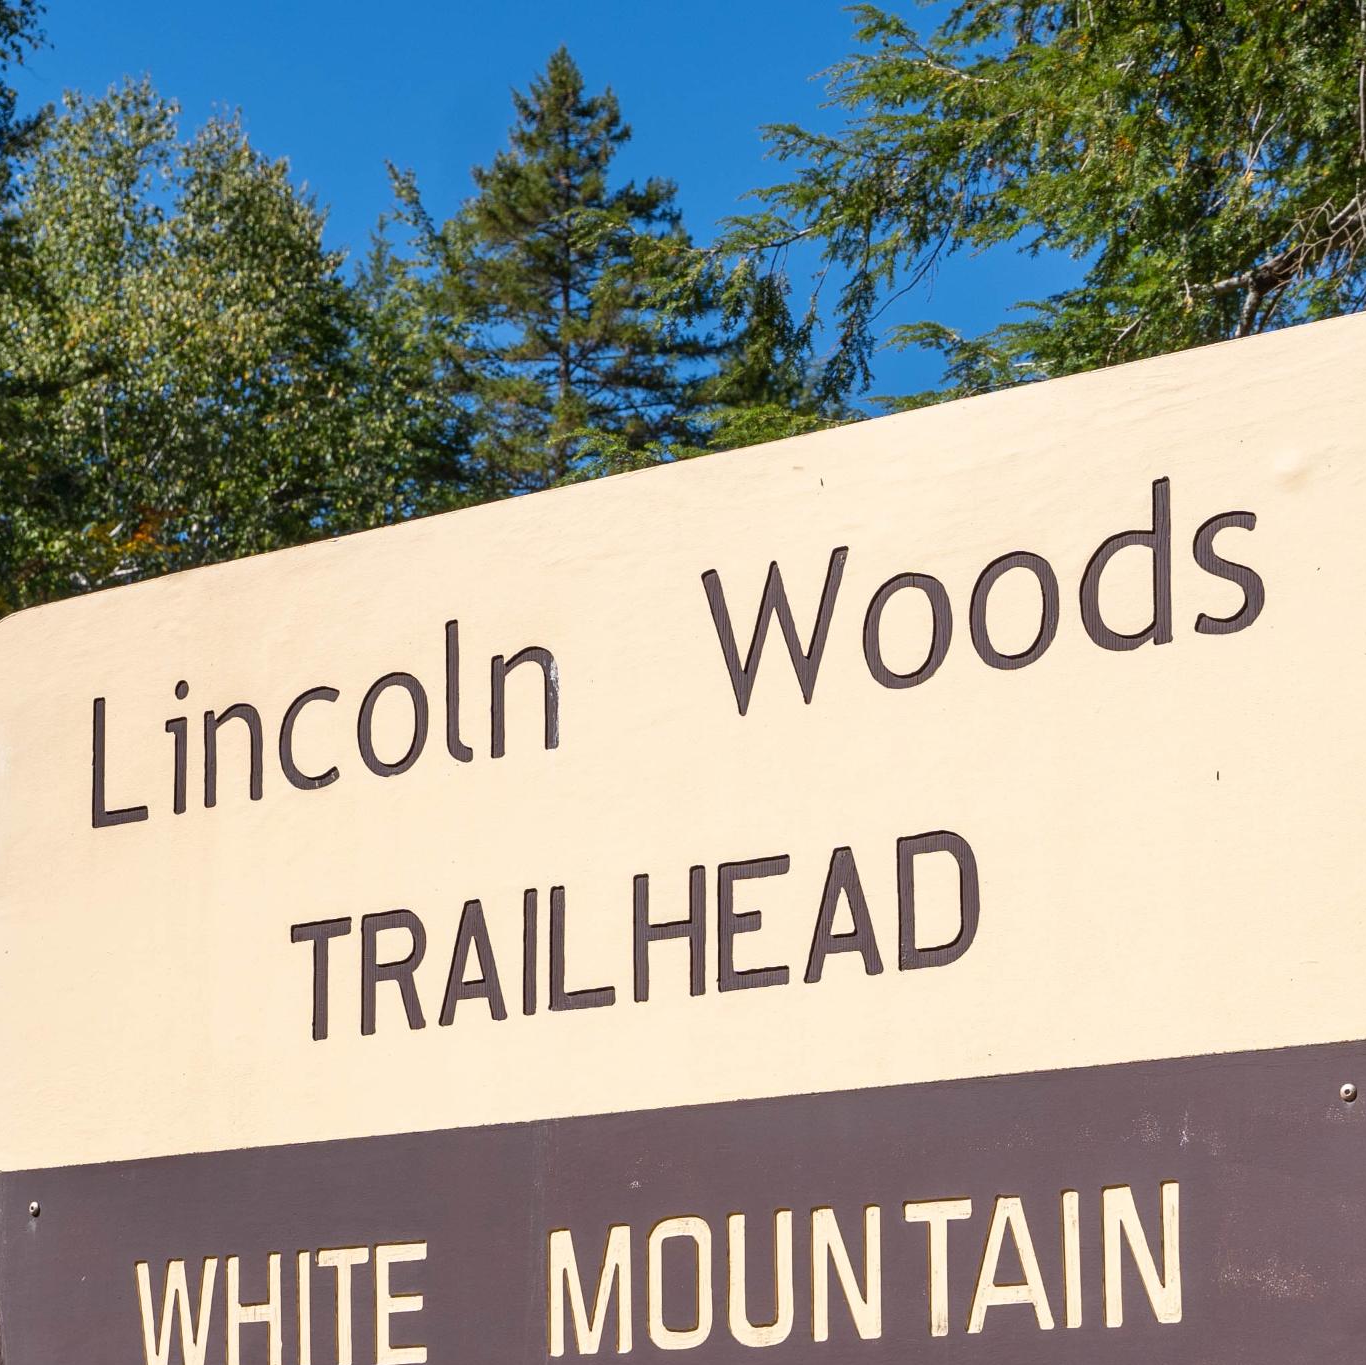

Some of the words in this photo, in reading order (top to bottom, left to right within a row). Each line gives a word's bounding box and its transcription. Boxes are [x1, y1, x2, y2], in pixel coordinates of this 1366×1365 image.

[90, 619, 559, 829] Lincoln
[701, 476, 1266, 717] Woods
[291, 830, 981, 1042] TRAILHEAD
[547, 1179, 1183, 1357] MOUNTAIN
